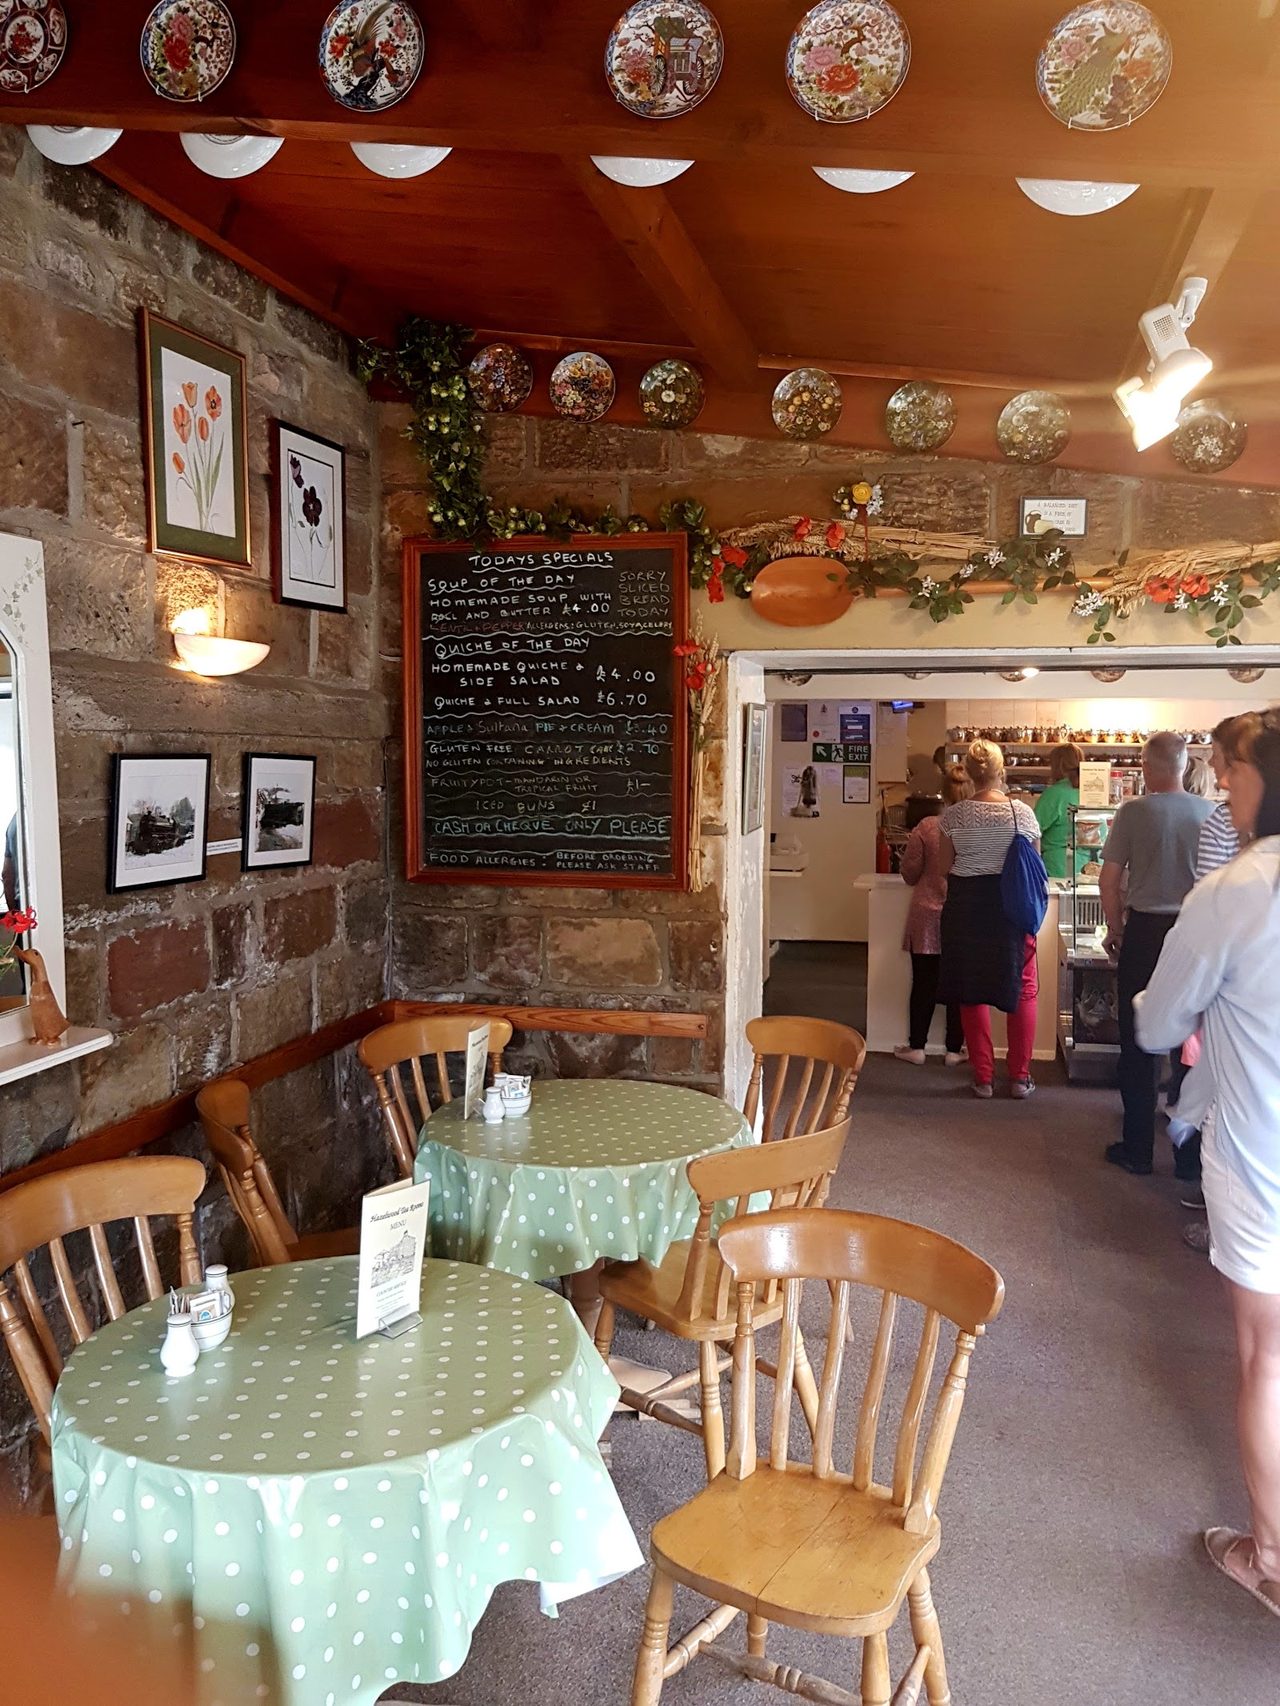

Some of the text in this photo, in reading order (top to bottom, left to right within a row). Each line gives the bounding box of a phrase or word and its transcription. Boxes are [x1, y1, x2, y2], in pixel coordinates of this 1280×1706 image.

[468, 552, 614, 567] TODAYS SPECIALS
[619, 570, 667, 582] SORRY
[428, 574, 575, 592] SOUP OF THE DAY
[618, 582, 670, 593] SLICED
[430, 592, 612, 607] HOMEMADE SOUP WITH
[620, 594, 670, 606] BREAD
[466, 610, 490, 620] AND
[500, 606, 552, 617] BUTTER
[617, 606, 668, 617] TODAY
[434, 638, 590, 658] QUICHE OF THE DAY
[431, 662, 511, 674] HOMEMADE
[516, 662, 568, 673] QUICHE
[460, 676, 560, 687] SIDE SALAD
[434, 696, 476, 710] QUICHE
[497, 696, 530, 706] FULL
[538, 696, 580, 706] SALAD
[427, 724, 464, 735] APPLE
[478, 720, 529, 734] Sultana
[570, 722, 615, 734] CREAM
[429, 744, 481, 754] GLUTEN
[486, 744, 514, 754] FREE
[848, 745, 869, 753] FIRE
[425, 759, 439, 768] NO
[442, 758, 481, 766] GLUTEN
[575, 775, 592, 783] OR
[514, 784, 598, 793] TROPICAL FRUIT
[476, 800, 504, 810] ICED
[517, 800, 556, 814] BUNS
[434, 820, 470, 835] CASH
[474, 822, 492, 833] OR
[565, 818, 602, 834] ONLY
[610, 818, 667, 834] PLEASE
[430, 853, 469, 864] FOOD
[475, 856, 536, 866] ALLERGIES
[556, 852, 595, 860] BEFORE
[602, 854, 654, 863] ORDERING
[556, 861, 660, 871] PLEASE ASK STAFF
[390, 1219, 408, 1230] MENU
